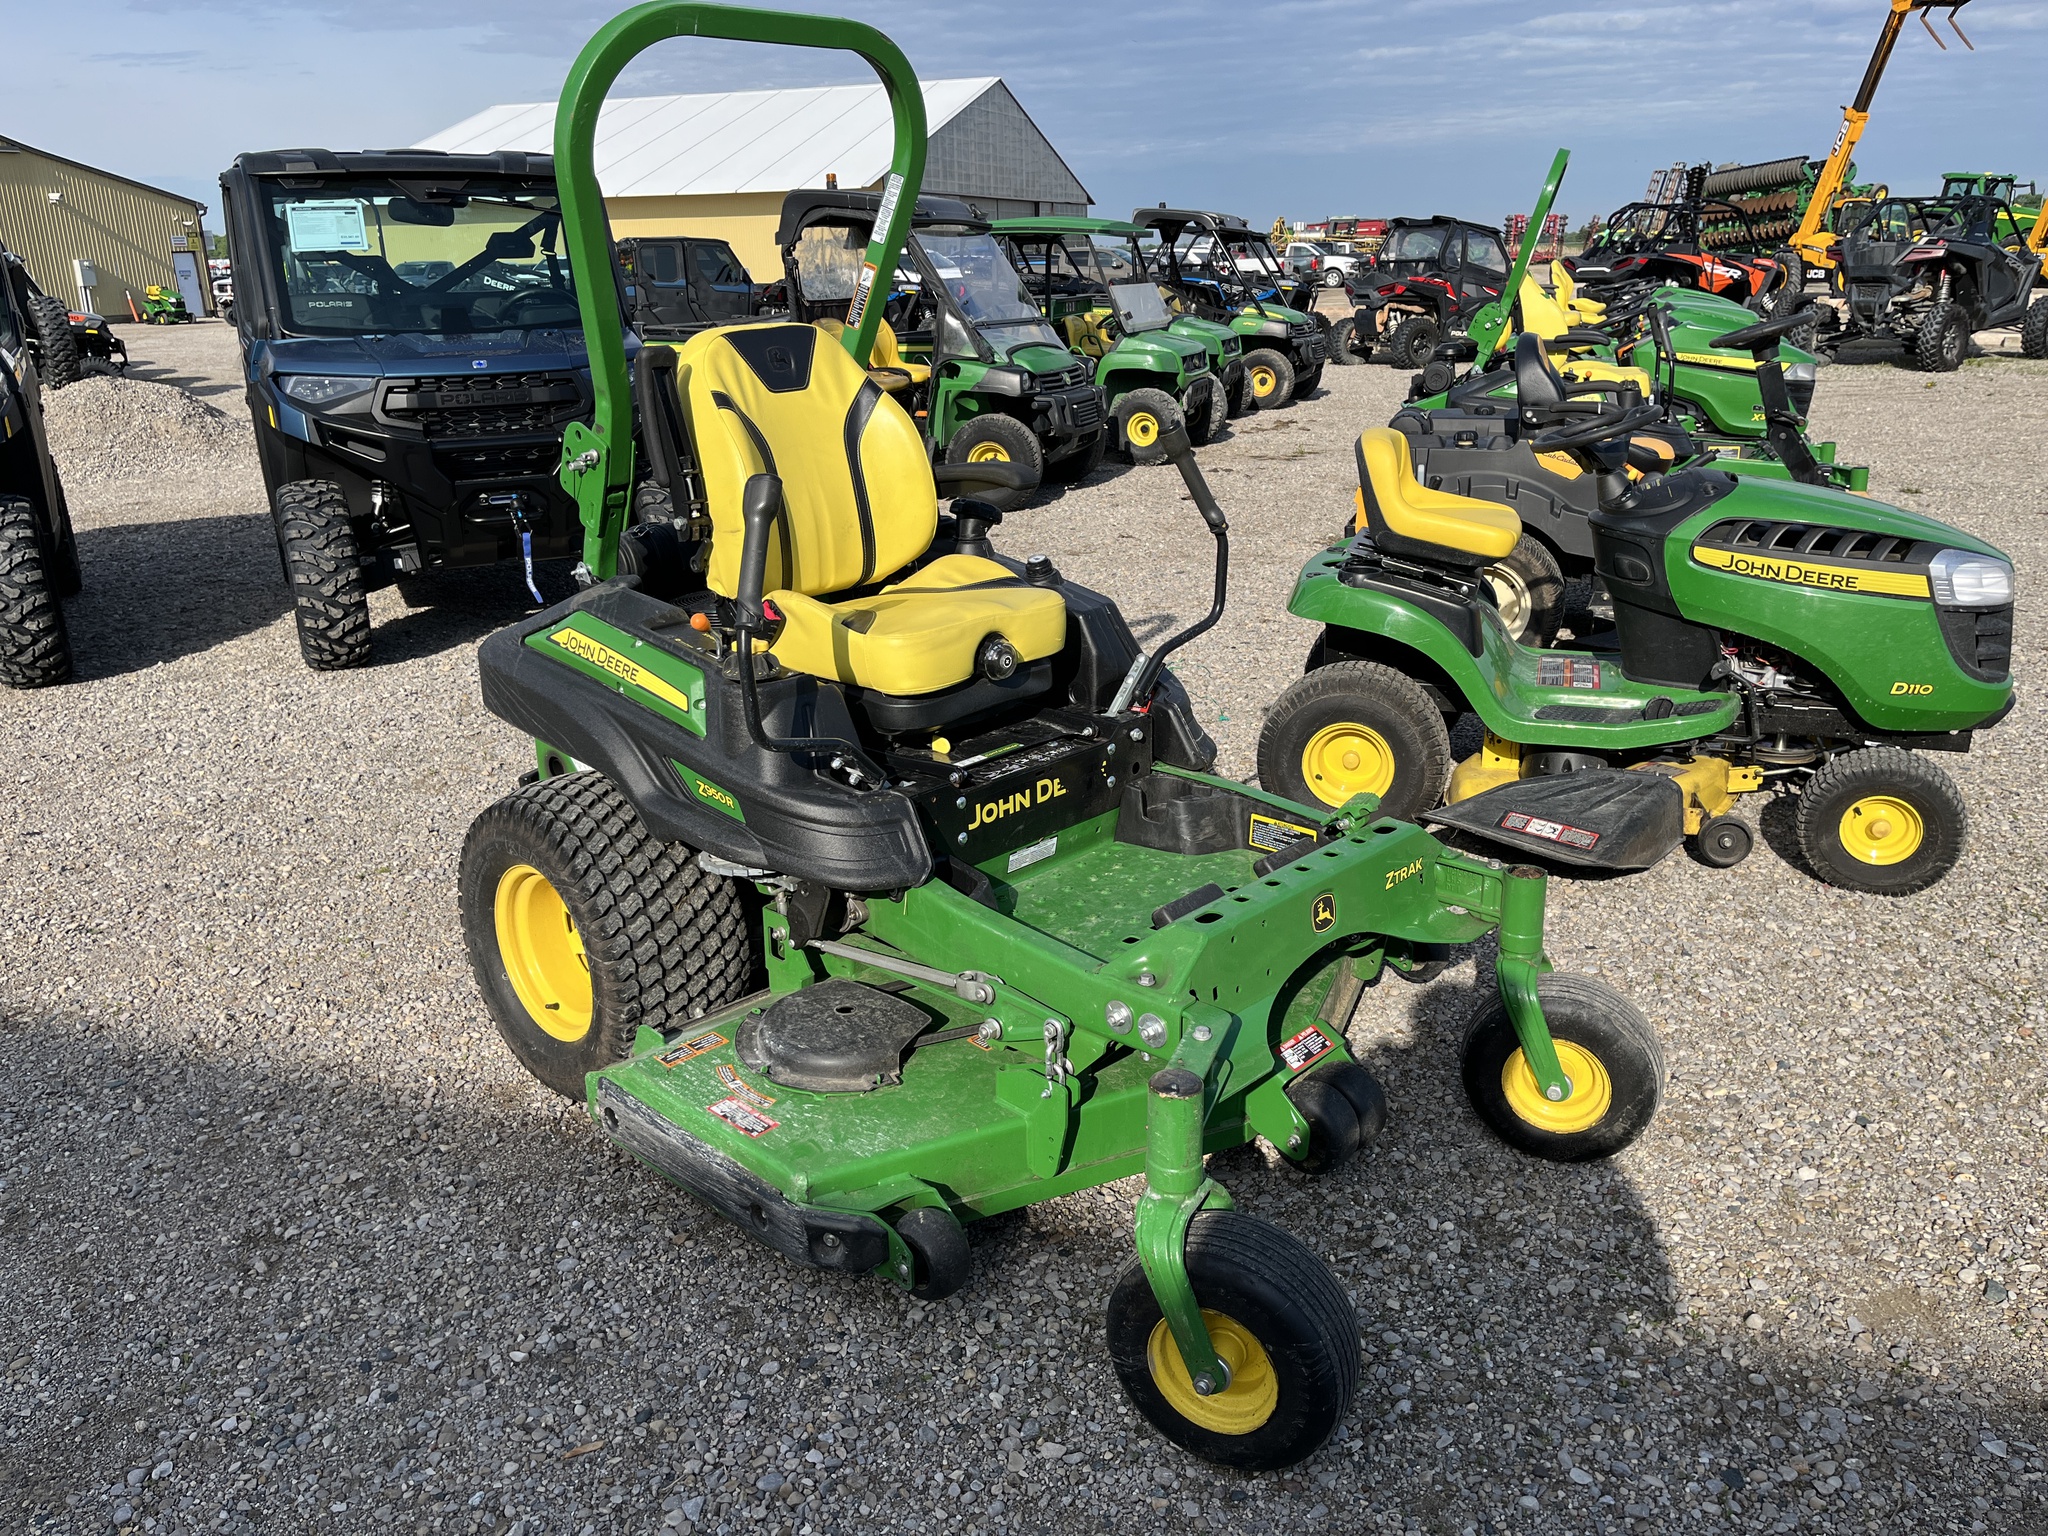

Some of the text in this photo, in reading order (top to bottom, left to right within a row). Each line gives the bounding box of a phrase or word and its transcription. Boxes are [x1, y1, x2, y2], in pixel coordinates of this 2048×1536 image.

[1831, 119, 1850, 157] JCB
[484, 276, 516, 292] DEERE
[1806, 269, 1825, 278] JCB
[1679, 354, 1723, 365] JOHN DEERE
[440, 391, 529, 406] POLARIS
[525, 557, 537, 593] POLARIS
[1722, 554, 1859, 589] JOHN DEERE
[562, 631, 640, 683] JOHN DEERE
[1890, 682, 1934, 695] D110
[695, 779, 735, 809] Z950R
[968, 789, 1030, 831] JOHN
[1385, 857, 1424, 891] ZTRAK
